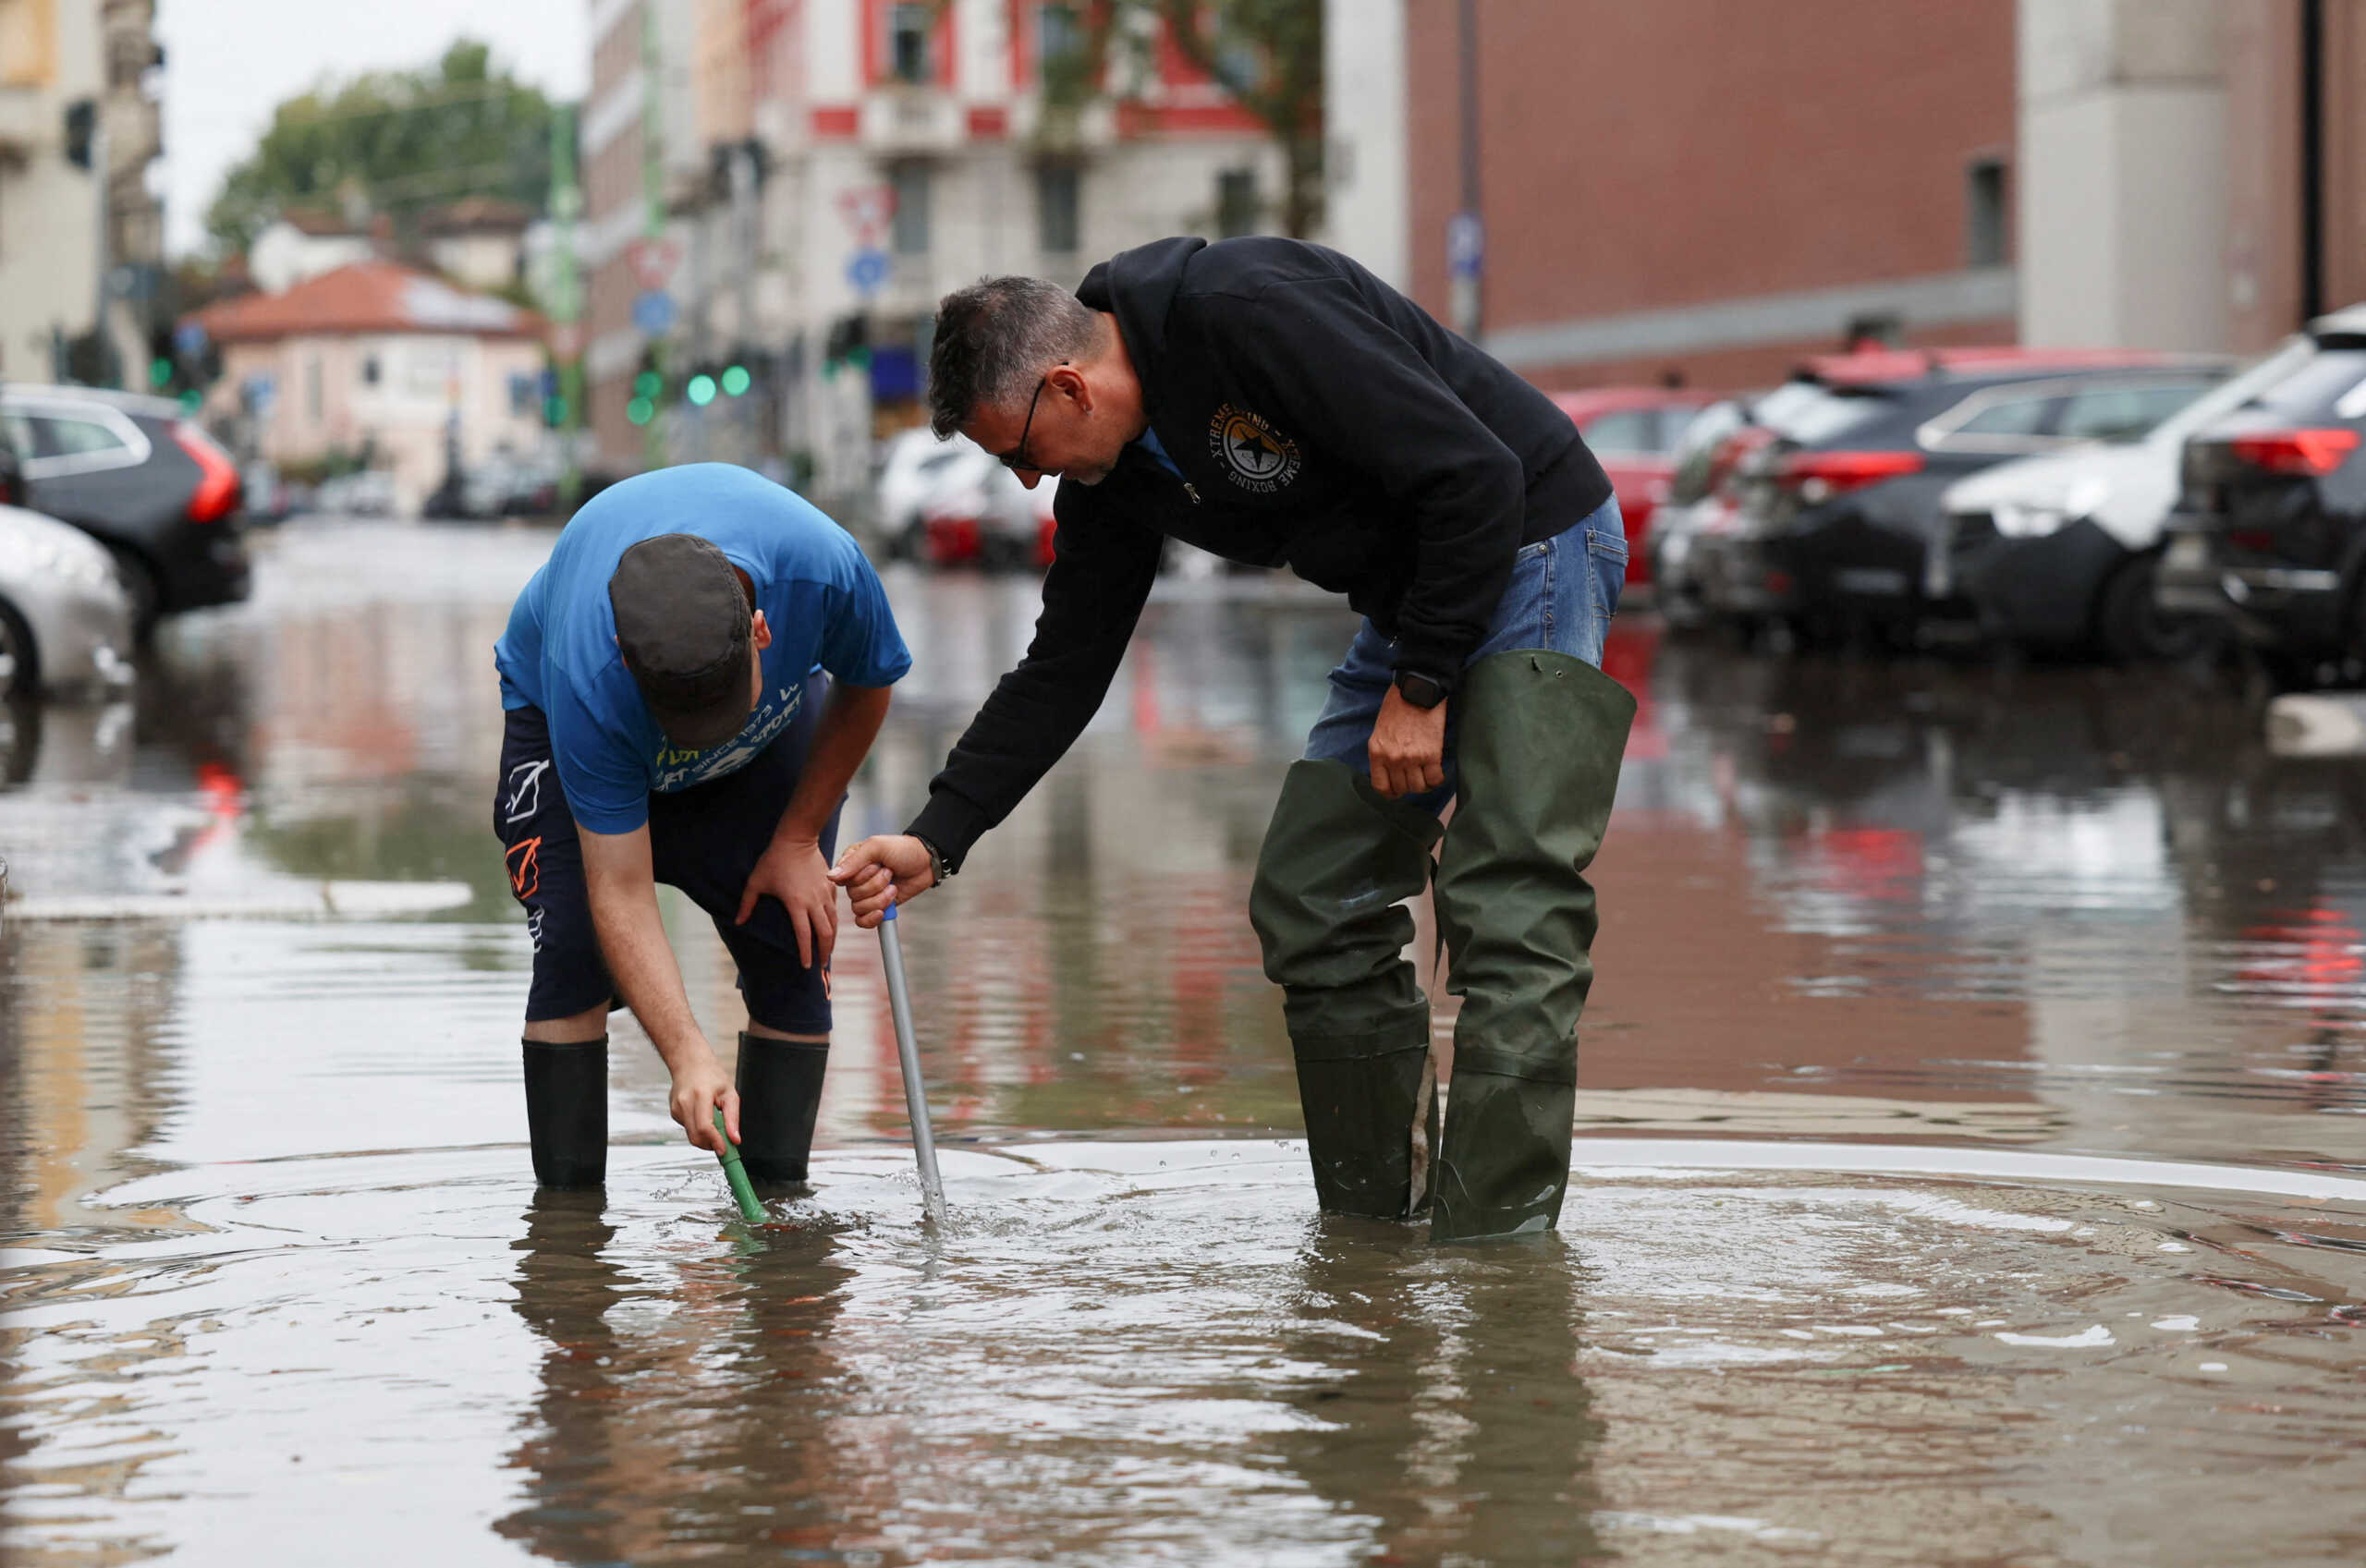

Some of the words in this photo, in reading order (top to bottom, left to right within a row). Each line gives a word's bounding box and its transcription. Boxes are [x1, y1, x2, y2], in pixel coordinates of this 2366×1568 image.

[1209, 403, 1233, 458] XTREME
[1227, 470, 1277, 492] BOXING
[693, 738, 739, 772] SINCE
